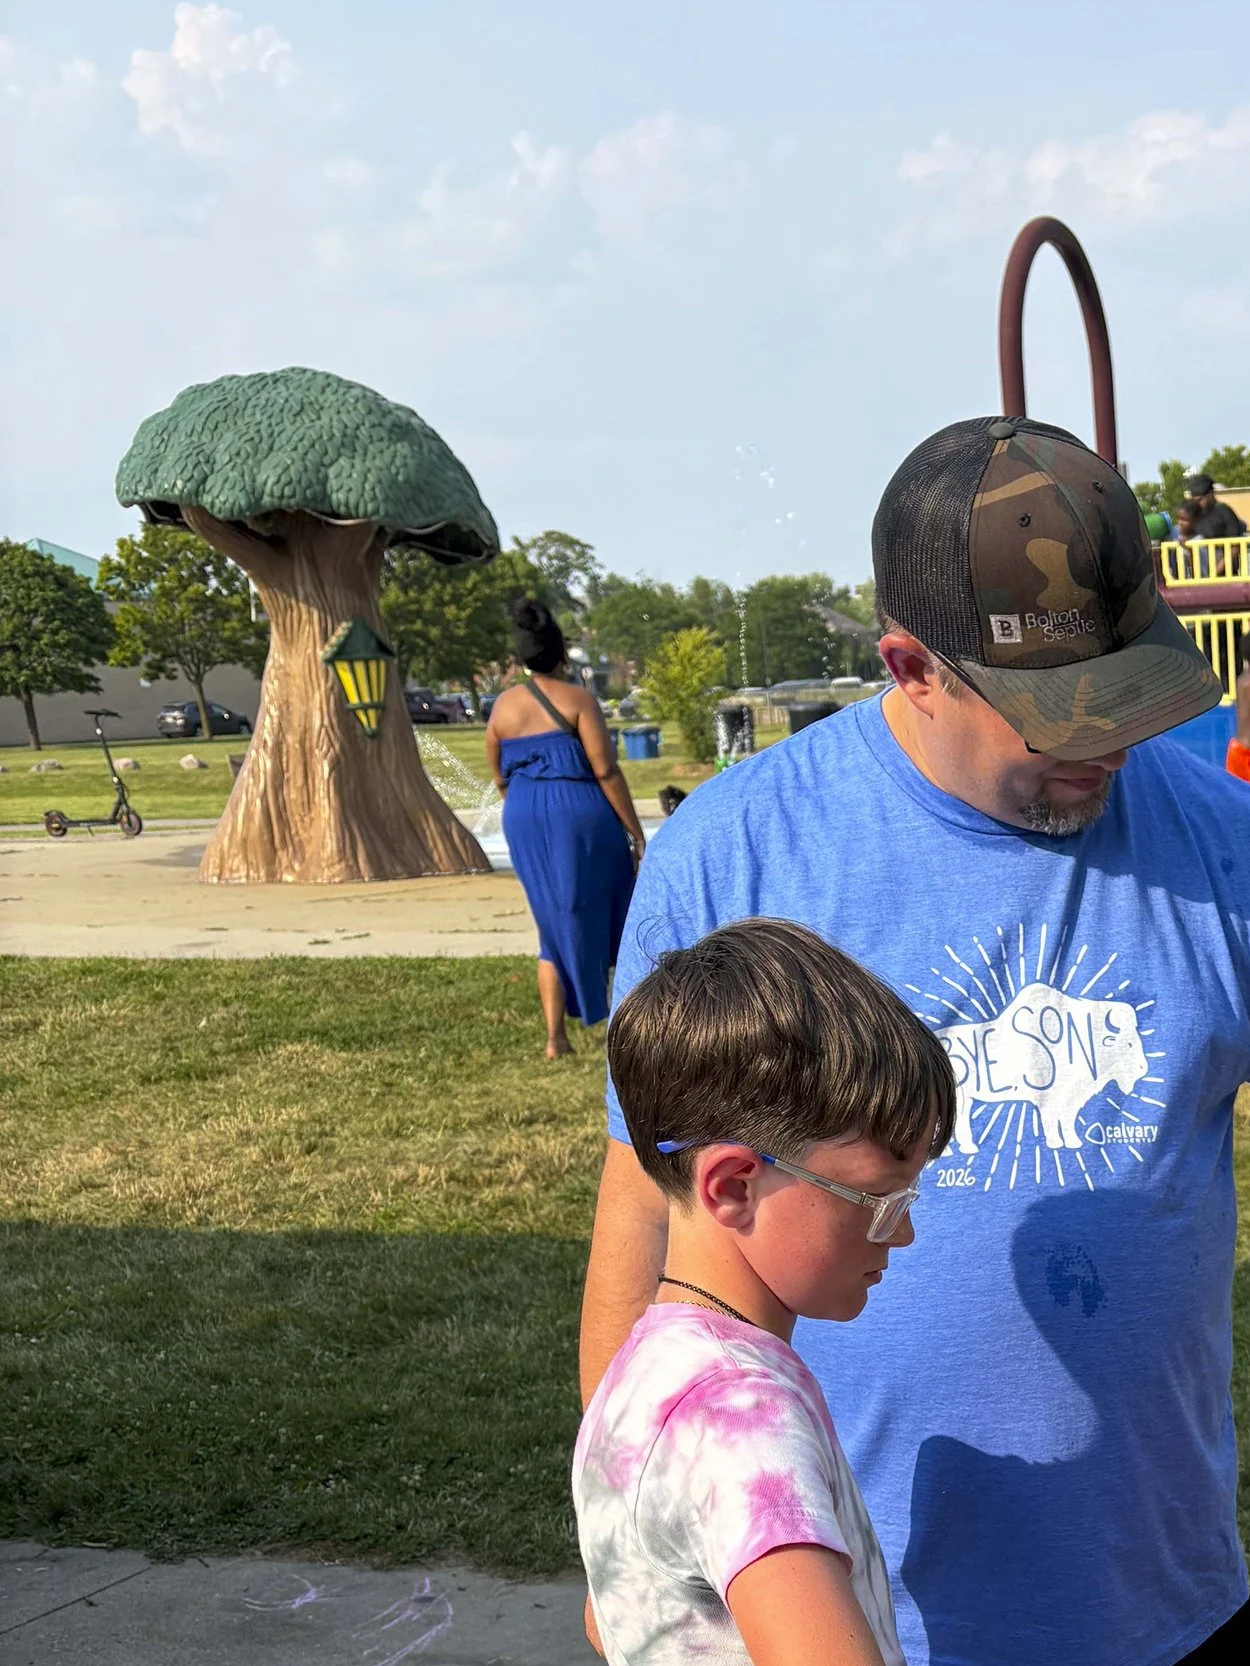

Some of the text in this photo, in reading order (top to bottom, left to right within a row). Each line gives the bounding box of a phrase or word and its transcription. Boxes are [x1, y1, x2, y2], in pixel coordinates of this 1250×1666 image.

[1025, 608, 1080, 629] Bolton
[1043, 620, 1096, 643] Septic
[1012, 1006, 1097, 1091] SON
[1105, 1122, 1158, 1142] calvary
[936, 1168, 976, 1187] 2026
